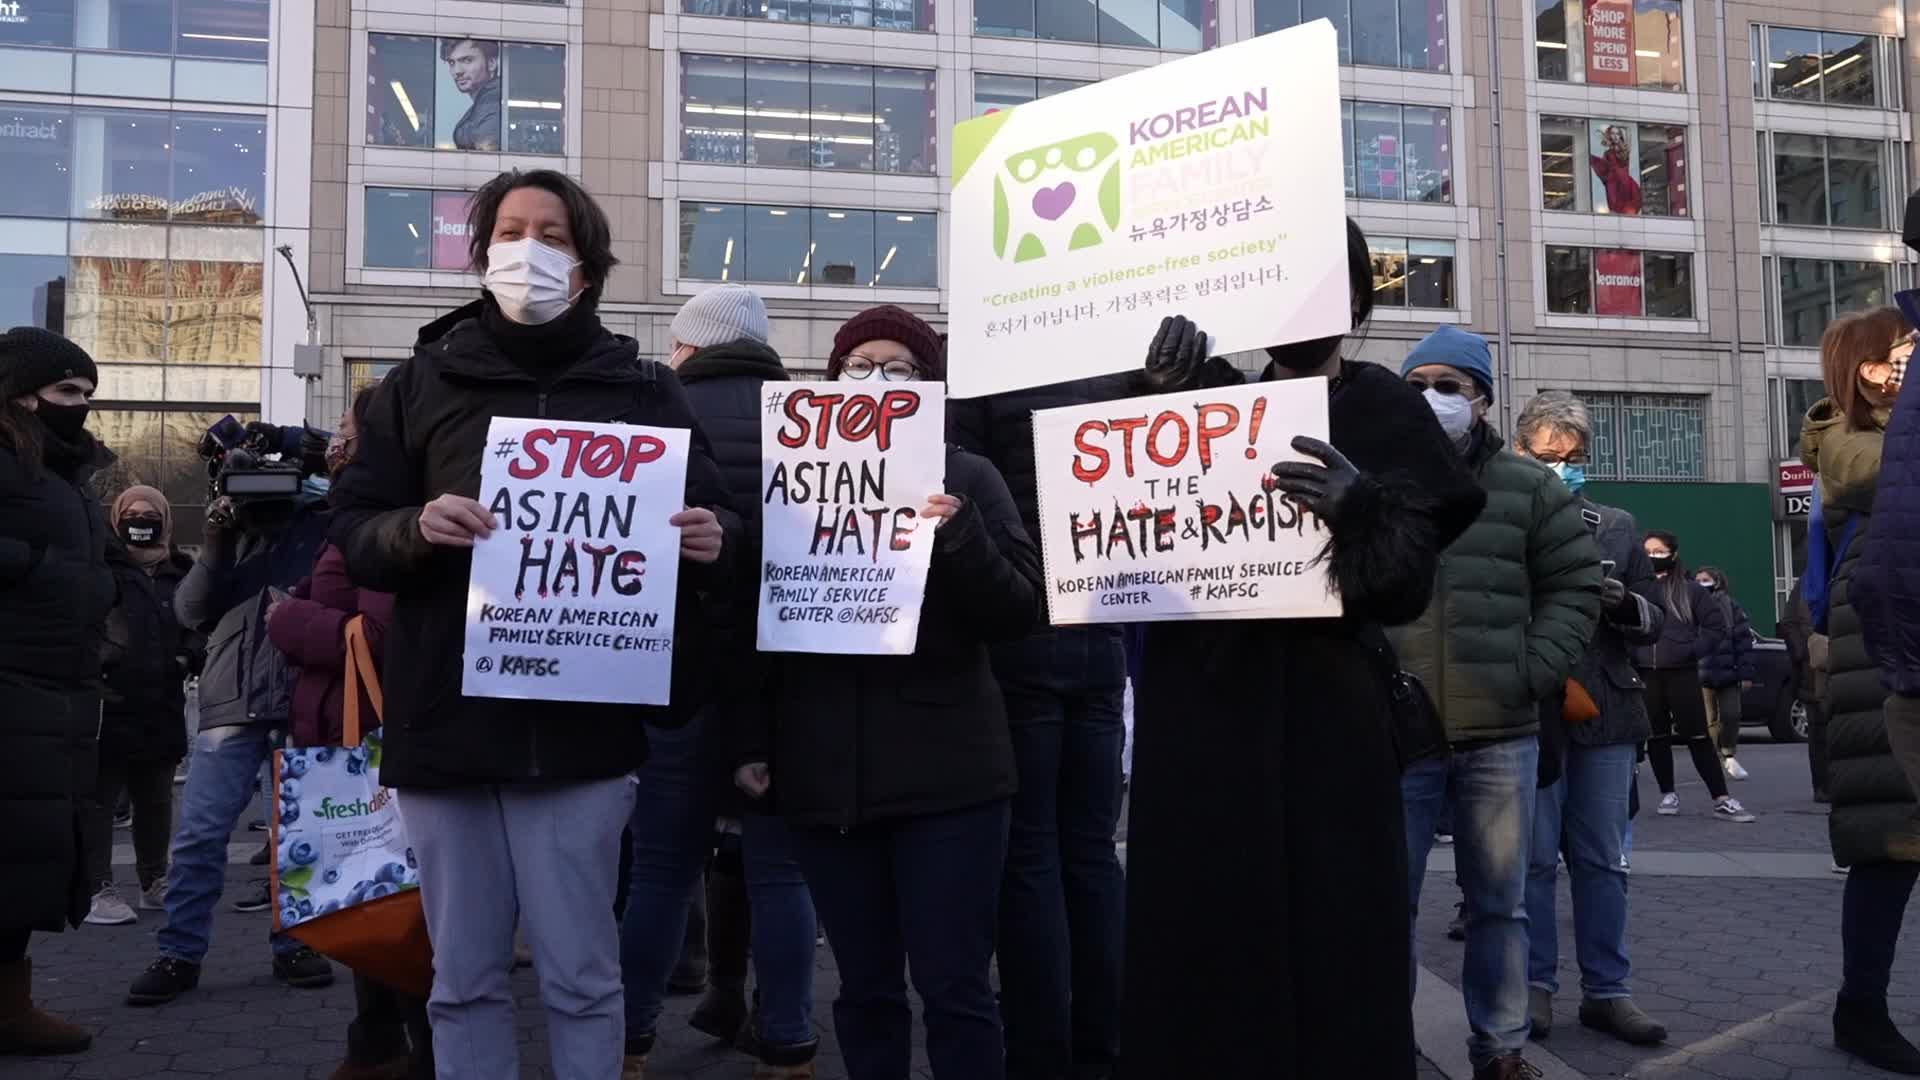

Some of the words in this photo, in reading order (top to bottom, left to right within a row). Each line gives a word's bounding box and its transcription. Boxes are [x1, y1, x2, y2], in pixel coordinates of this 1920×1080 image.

[1593, 9, 1624, 24] SHOP
[1593, 25, 1626, 40] MORE
[1593, 41, 1627, 55] SPEND
[1600, 58, 1623, 69] LESS
[1129, 86, 1268, 146] KOREAN
[0, 121, 56, 139] ntract
[1130, 115, 1269, 169] AMERICAN
[1129, 144, 1268, 200] FAMILY
[1129, 195, 1274, 242] 뉴욕가정상담소
[1067, 280, 1076, 291] a
[1082, 255, 1200, 288] violence-free
[1595, 269, 1640, 287] learance
[1106, 284, 1188, 312] 가정폭력은
[1072, 396, 1267, 487] STOP!
[765, 457, 886, 505] ASIAN
[1145, 475, 1200, 500] THE
[489, 487, 637, 538] ASIAN
[808, 505, 919, 563] HATE
[1069, 495, 1176, 564] HATE
[514, 533, 647, 602] HATE
[764, 561, 819, 582] KOREAN
[820, 563, 895, 582] AMERICAN
[1057, 574, 1115, 594] KOREAN
[1117, 568, 1184, 589] AMERICAN
[1187, 564, 1235, 582] FAMILY
[1239, 561, 1303, 578] SERVICE
[769, 585, 819, 604] FAMILY
[824, 587, 888, 603] SERVICE
[1100, 591, 1151, 606] CENTER
[480, 604, 553, 624] KOREAN
[558, 607, 658, 628] AMERICAN
[779, 605, 833, 623] CENTER
[489, 627, 544, 644] FAMILY
[545, 628, 611, 648] SERVICE
[613, 634, 671, 652] CENTER
